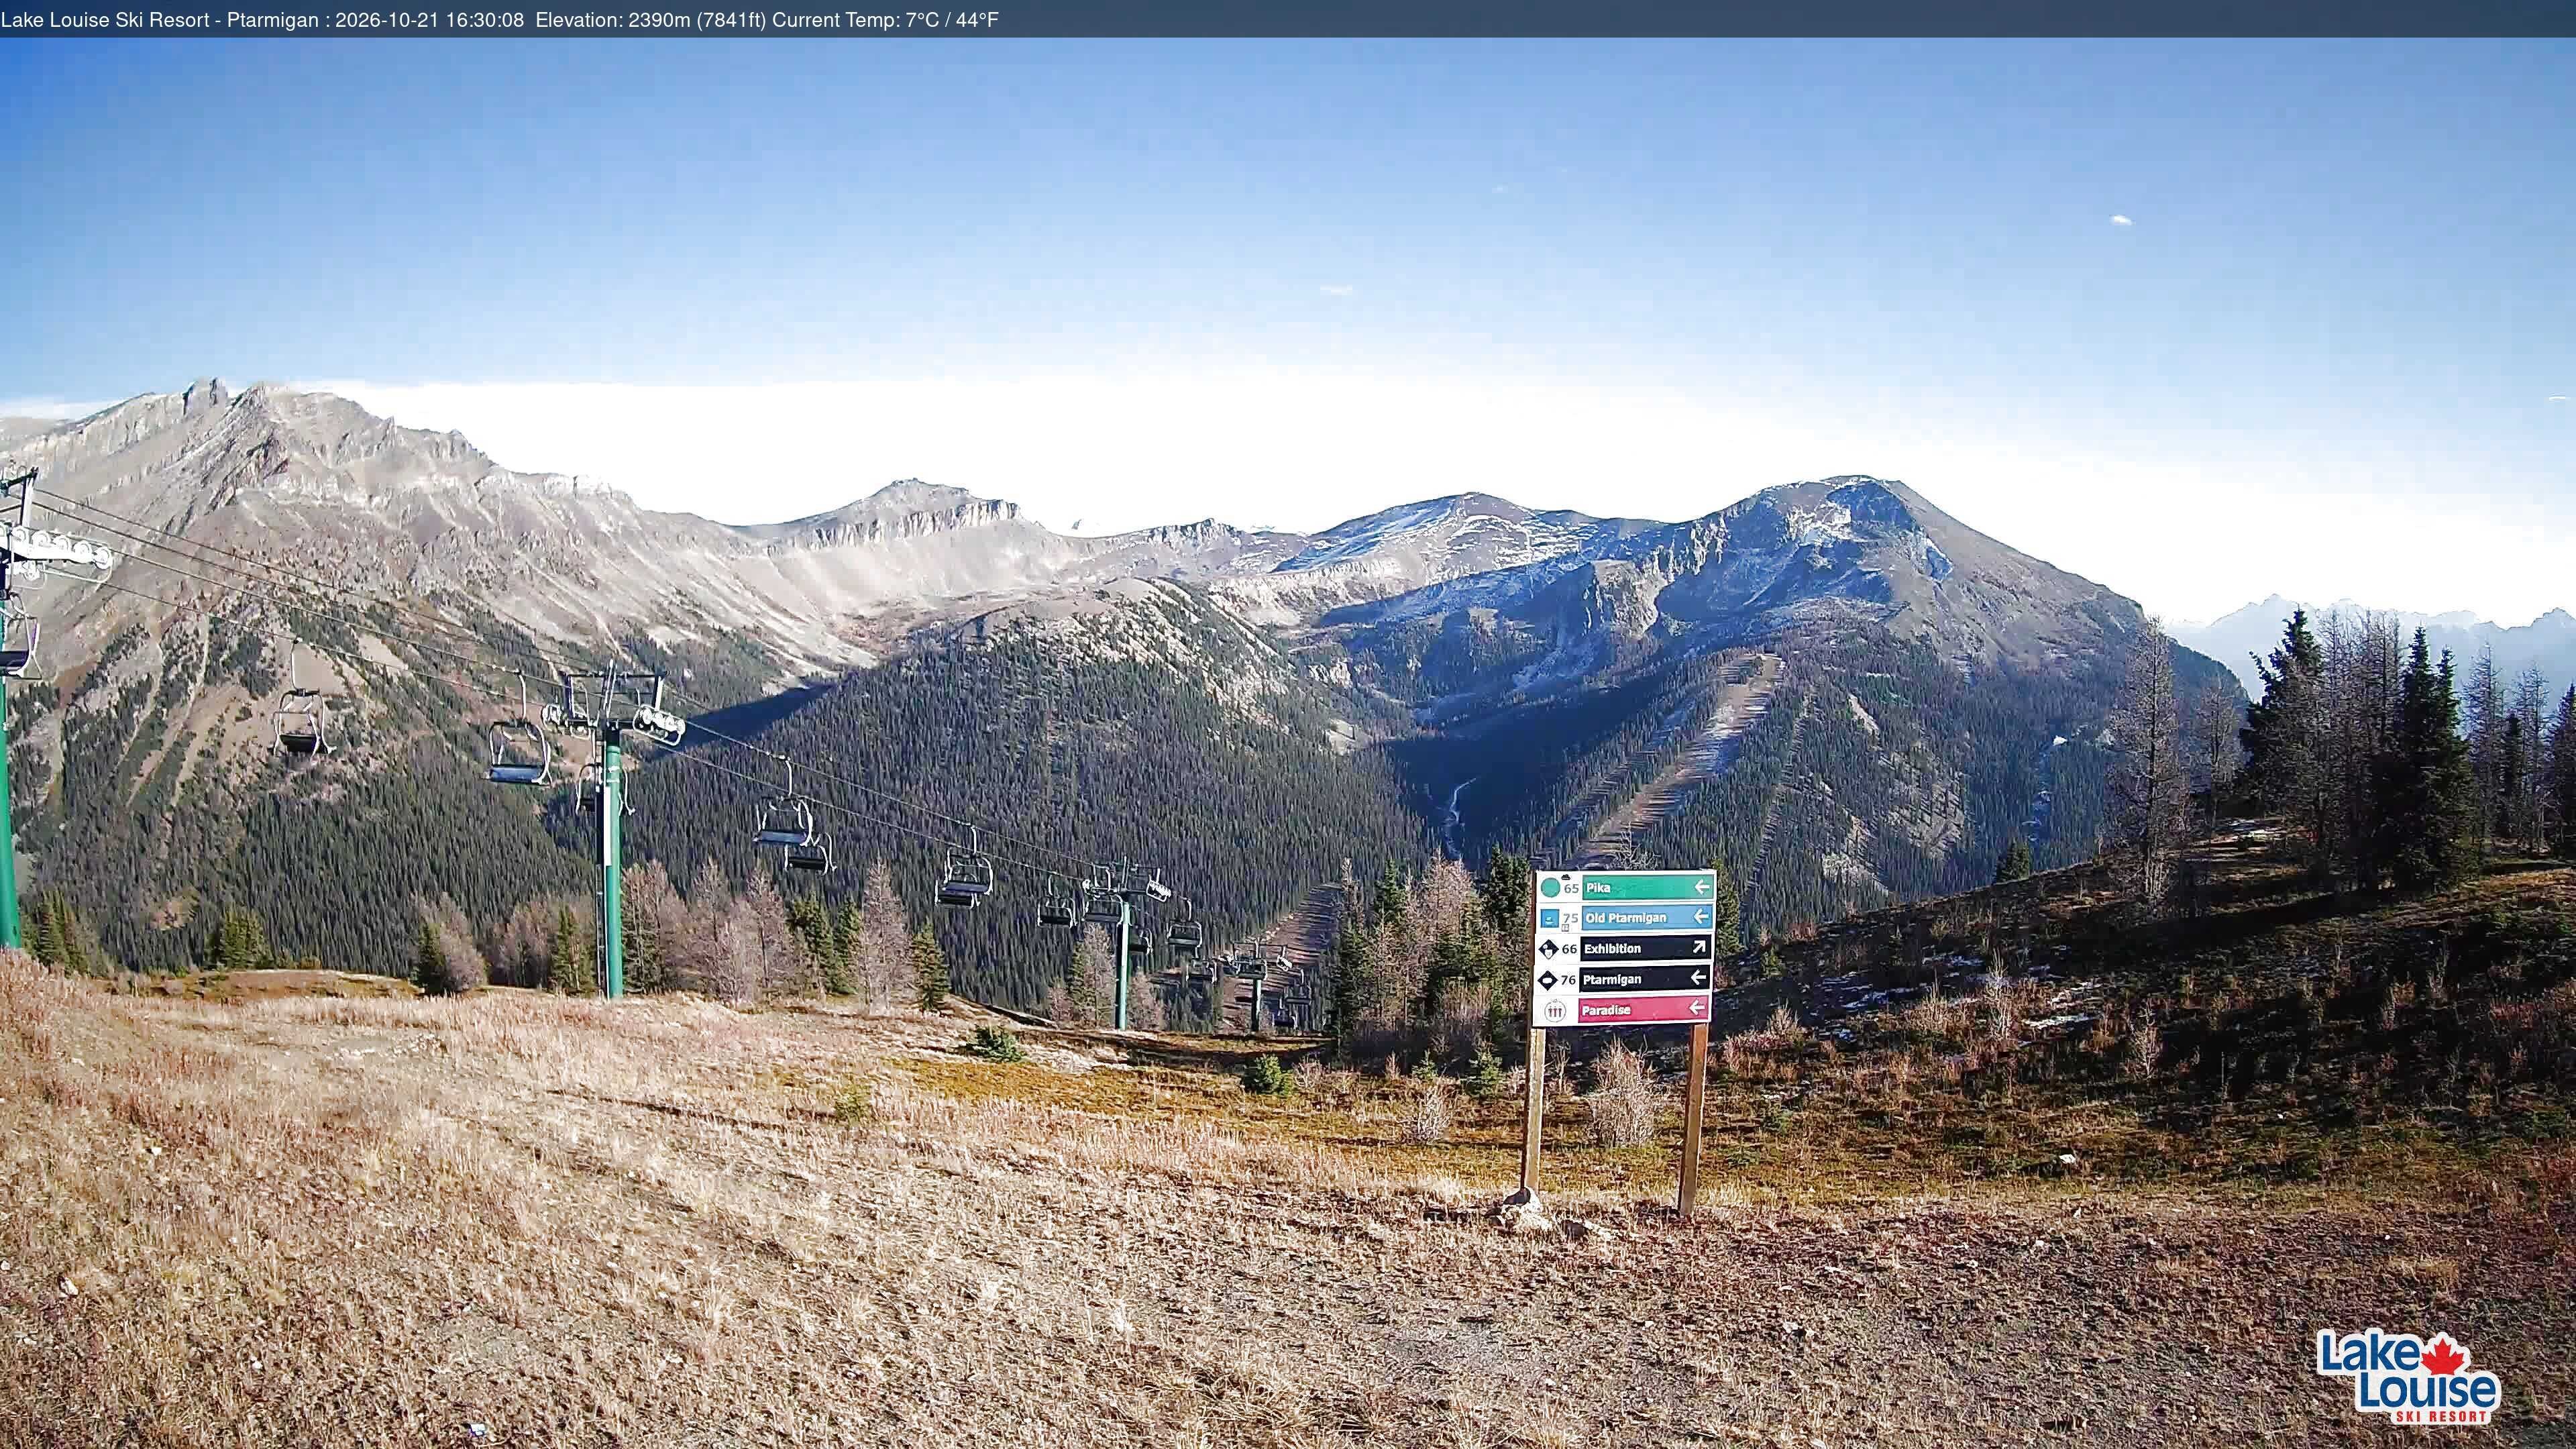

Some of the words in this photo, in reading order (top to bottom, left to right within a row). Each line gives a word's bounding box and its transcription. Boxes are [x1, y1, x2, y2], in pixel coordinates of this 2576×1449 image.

[1564, 884, 1579, 894] 65
[1587, 883, 1611, 893] Pika
[1563, 914, 1578, 923] 75
[1586, 913, 1605, 923] Old
[1609, 913, 1666, 924] Ptarmigan
[1562, 945, 1577, 954] 66
[1585, 943, 1642, 954] Exhibition
[1561, 975, 1576, 985] 76
[1583, 974, 1642, 986] Ptarmigan
[1582, 1005, 1631, 1016] Paradise
